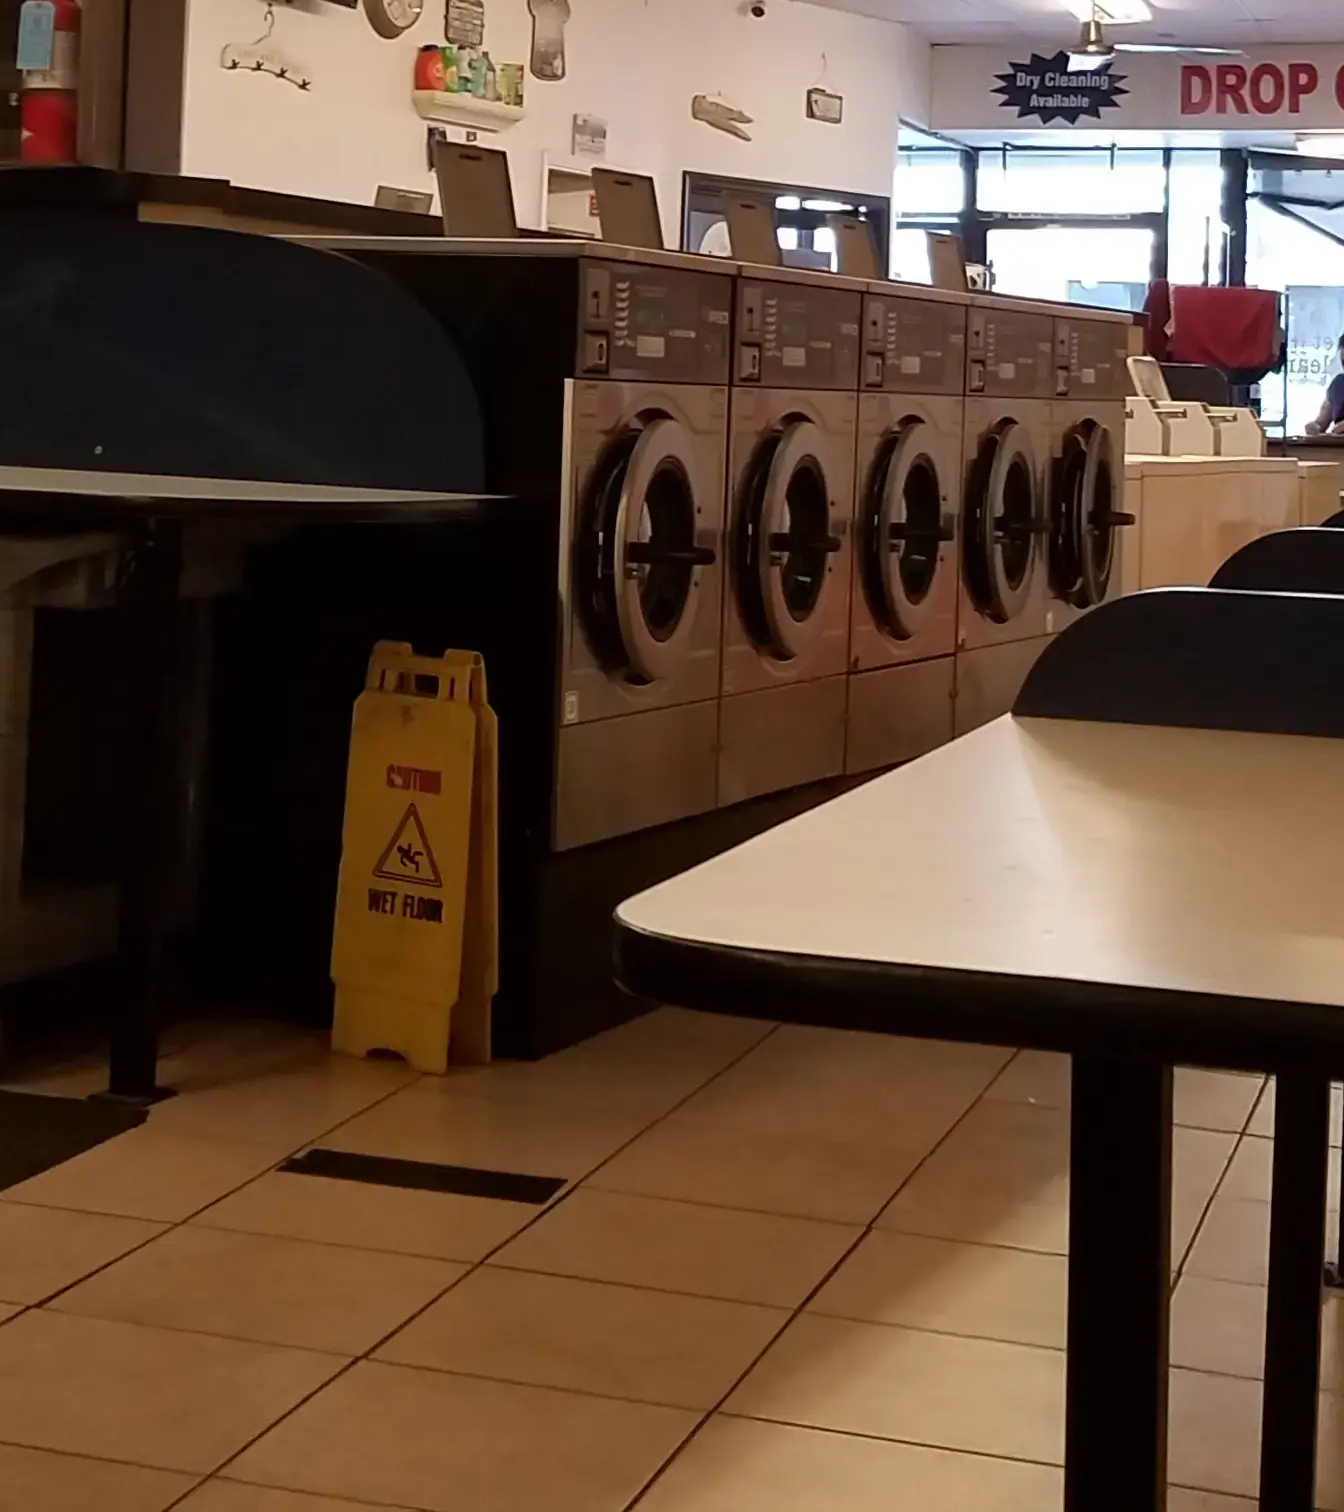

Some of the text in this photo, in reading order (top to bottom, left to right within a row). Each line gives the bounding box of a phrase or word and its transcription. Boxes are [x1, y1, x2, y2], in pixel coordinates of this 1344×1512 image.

[1016, 70, 1109, 90] Dry Cleaning
[1180, 62, 1319, 115] DROP
[1030, 94, 1091, 108] Available
[368, 888, 398, 915] WET
